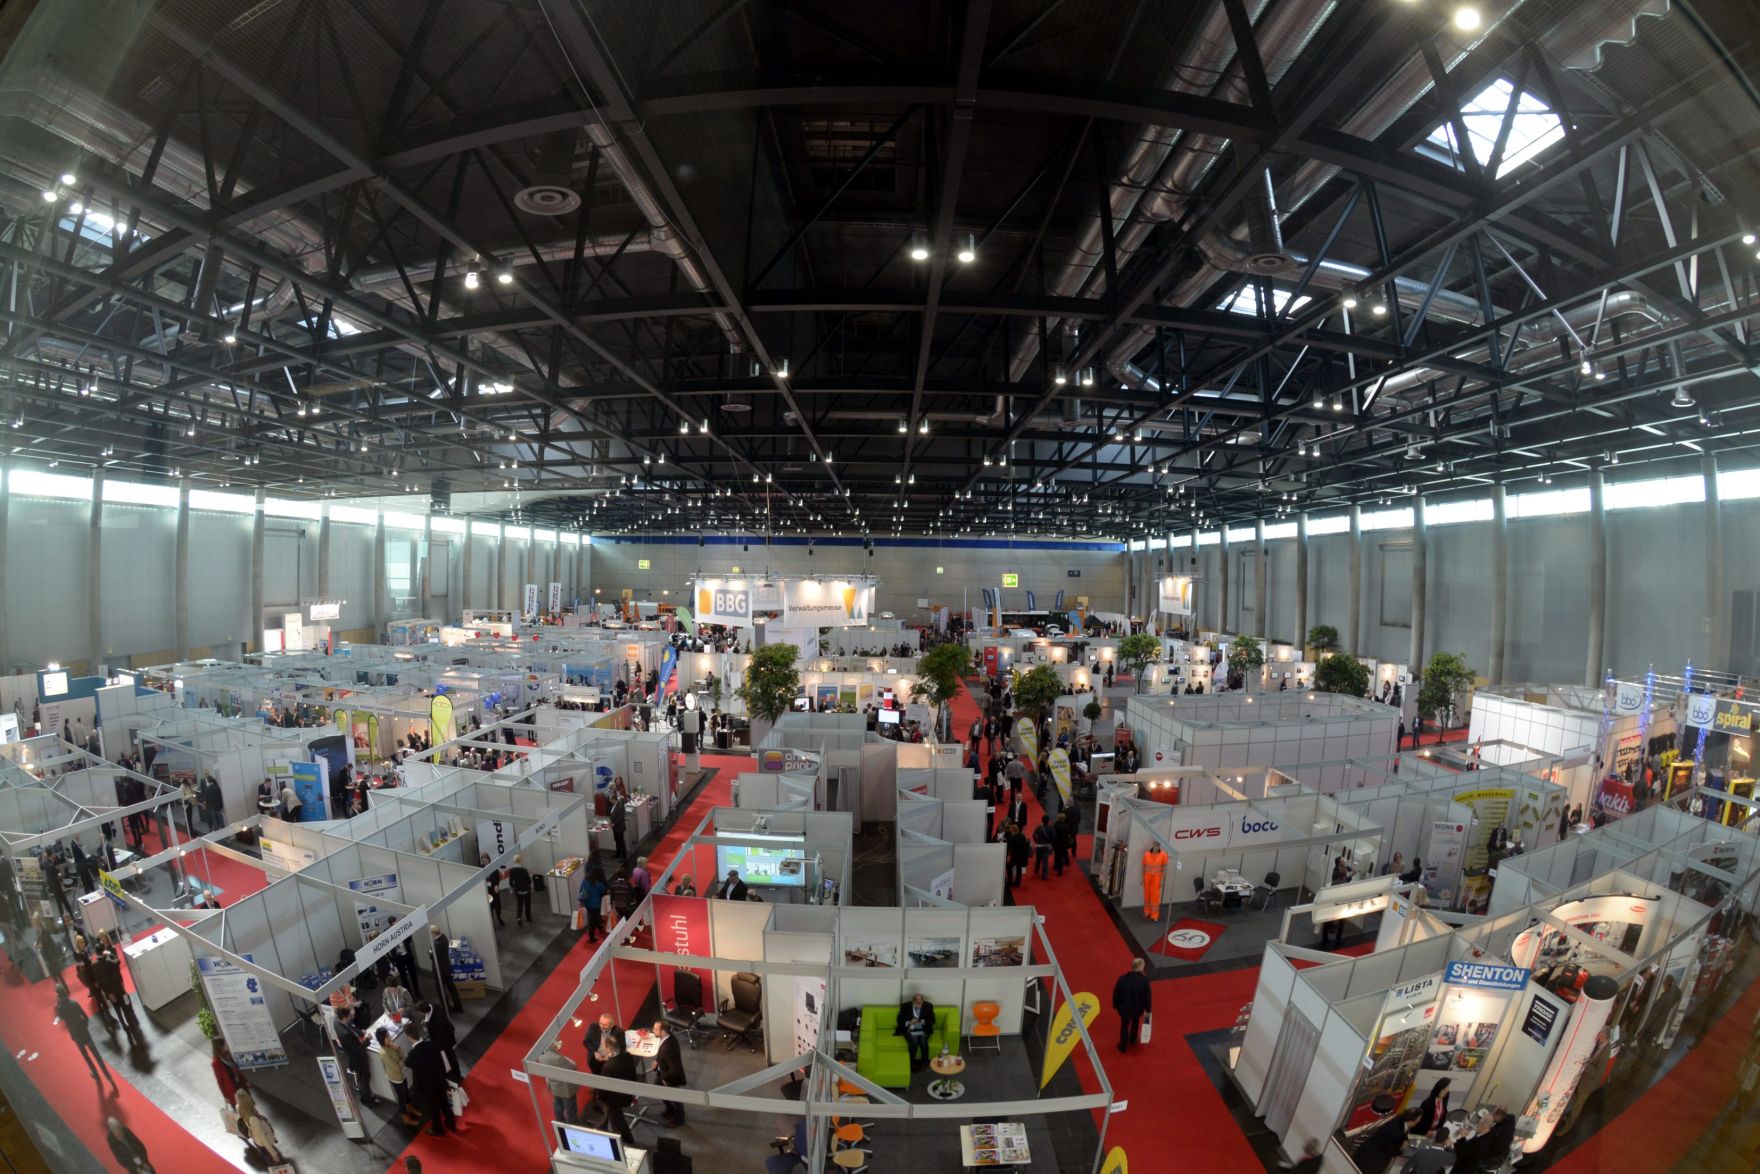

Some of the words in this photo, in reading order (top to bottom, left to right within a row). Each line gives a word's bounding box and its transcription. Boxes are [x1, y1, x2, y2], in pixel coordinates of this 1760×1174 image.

[716, 592, 747, 614] BBG
[788, 604, 842, 613] Verwaltungsmesse
[280, 692, 297, 701] Canon
[1622, 691, 1636, 706] bbo
[1692, 705, 1708, 720] bbo
[1717, 712, 1752, 729] spiral
[1175, 827, 1221, 840] CWS
[373, 936, 391, 954] HORN
[390, 920, 413, 942] AUSTRIA
[1451, 963, 1525, 983] SHENTON
[1404, 978, 1433, 995] LISTA
